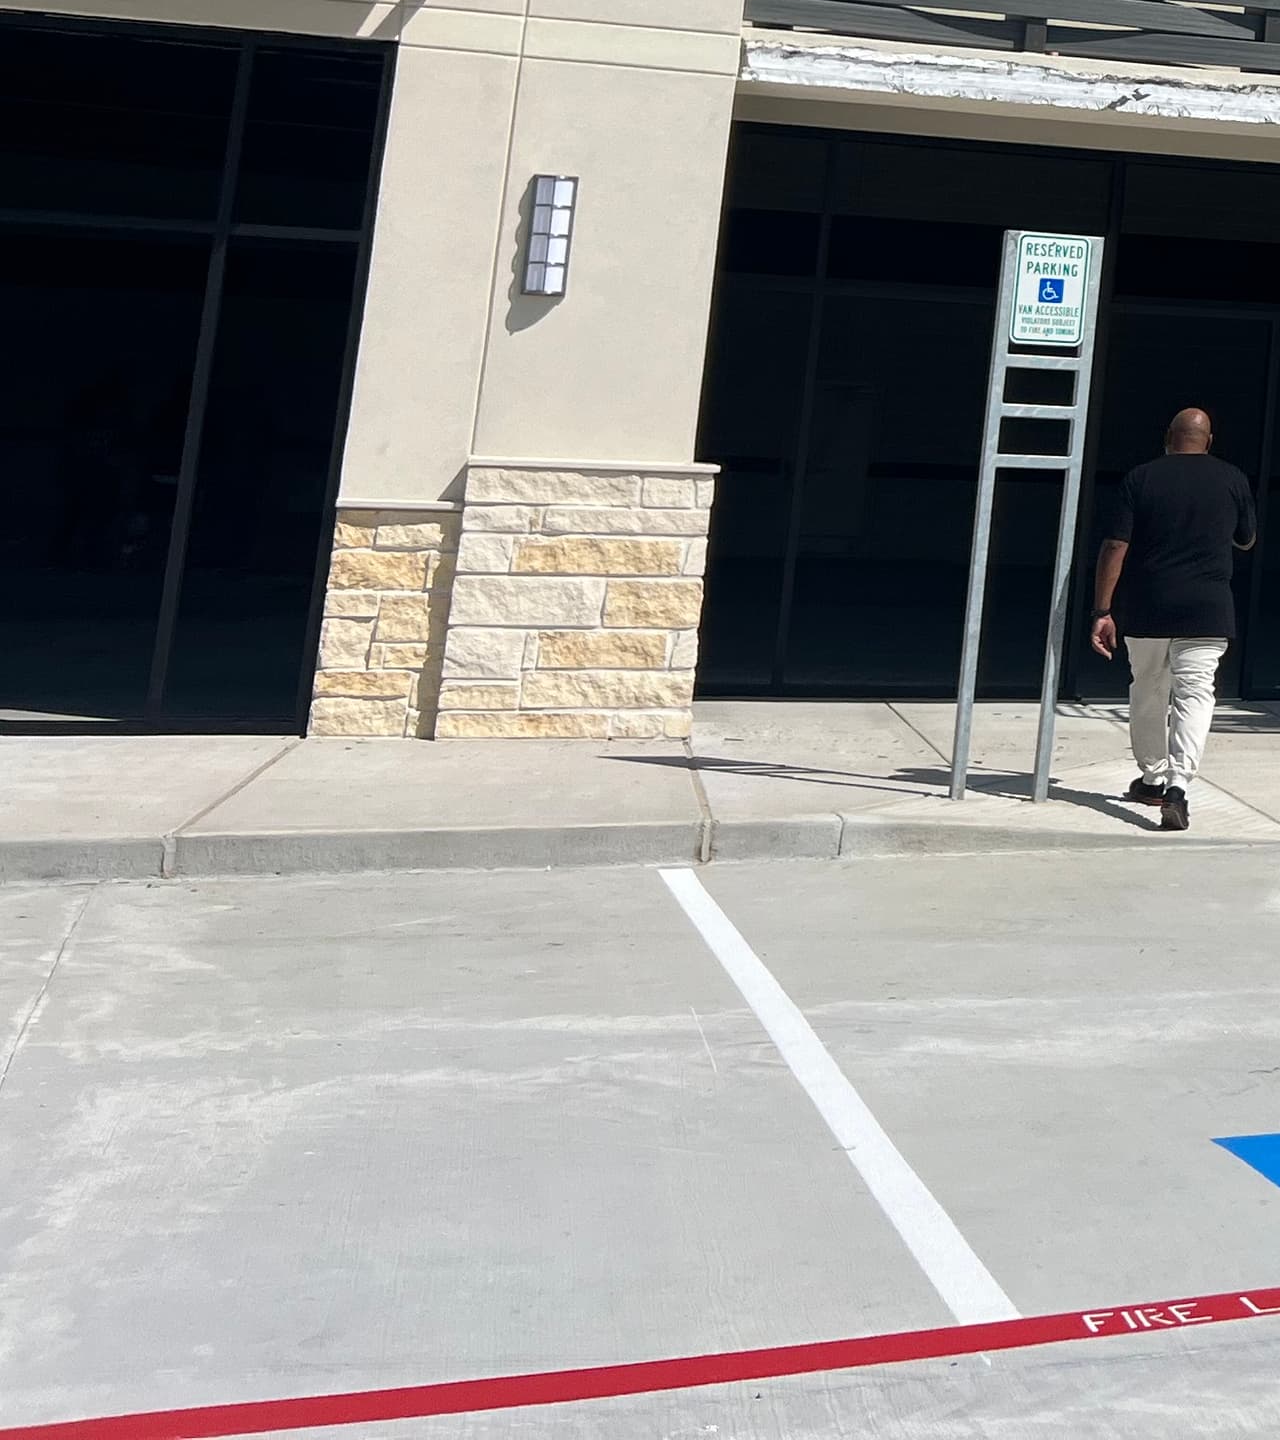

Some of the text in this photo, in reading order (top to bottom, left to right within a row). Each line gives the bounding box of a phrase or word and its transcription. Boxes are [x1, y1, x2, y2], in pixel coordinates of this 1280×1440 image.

[1026, 242, 1084, 259] RESERVED
[1026, 261, 1078, 277] PARKING
[1018, 304, 1079, 317] VAN ACCESSIBLE
[1082, 1302, 1213, 1333] FIRE
